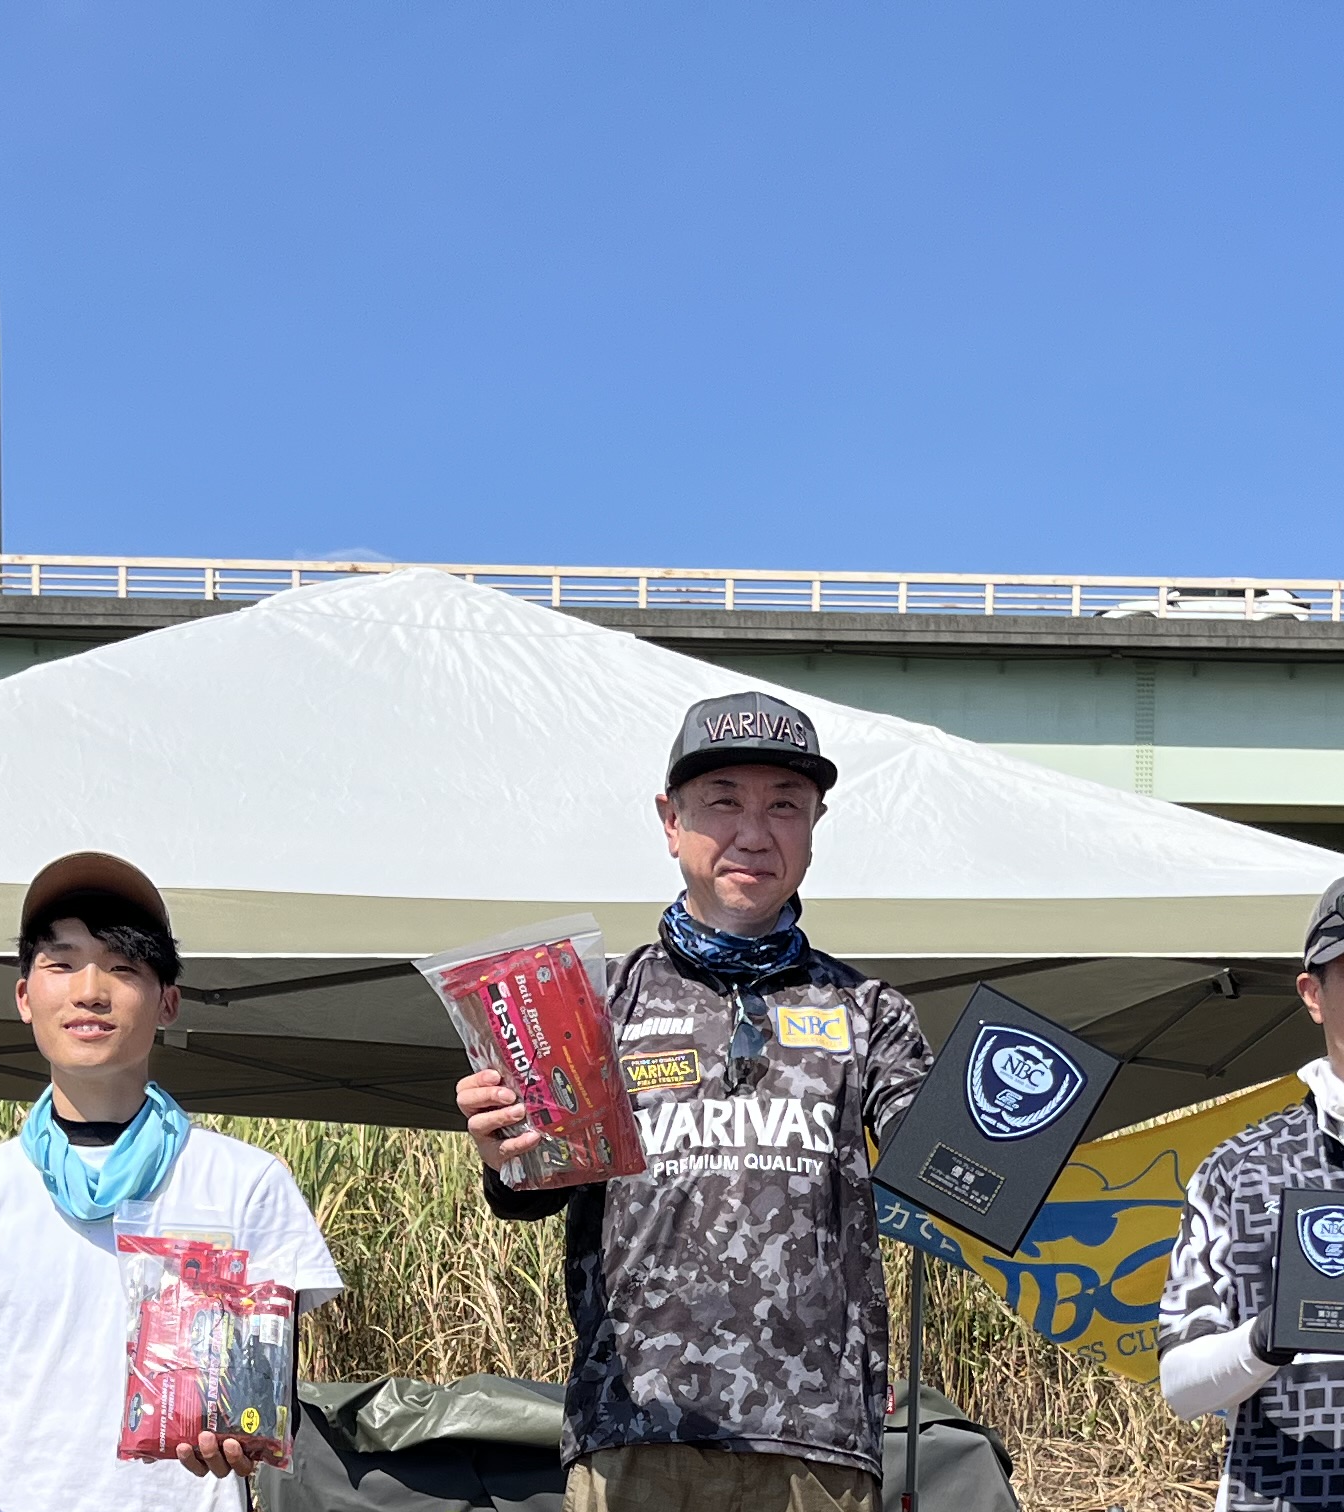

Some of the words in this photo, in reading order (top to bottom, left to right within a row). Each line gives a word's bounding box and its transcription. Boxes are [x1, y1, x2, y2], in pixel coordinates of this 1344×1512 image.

[706, 711, 807, 748] VARIVAS
[514, 974, 534, 1007] Bait
[526, 1006, 551, 1057] Breath
[784, 1014, 843, 1041] NBC
[627, 1061, 691, 1082] VARIVAS
[1001, 1053, 1046, 1088] NBC
[634, 1097, 837, 1155] VARIVAS
[653, 1154, 739, 1178] PREMIUM
[743, 1153, 824, 1176] QUALITY
